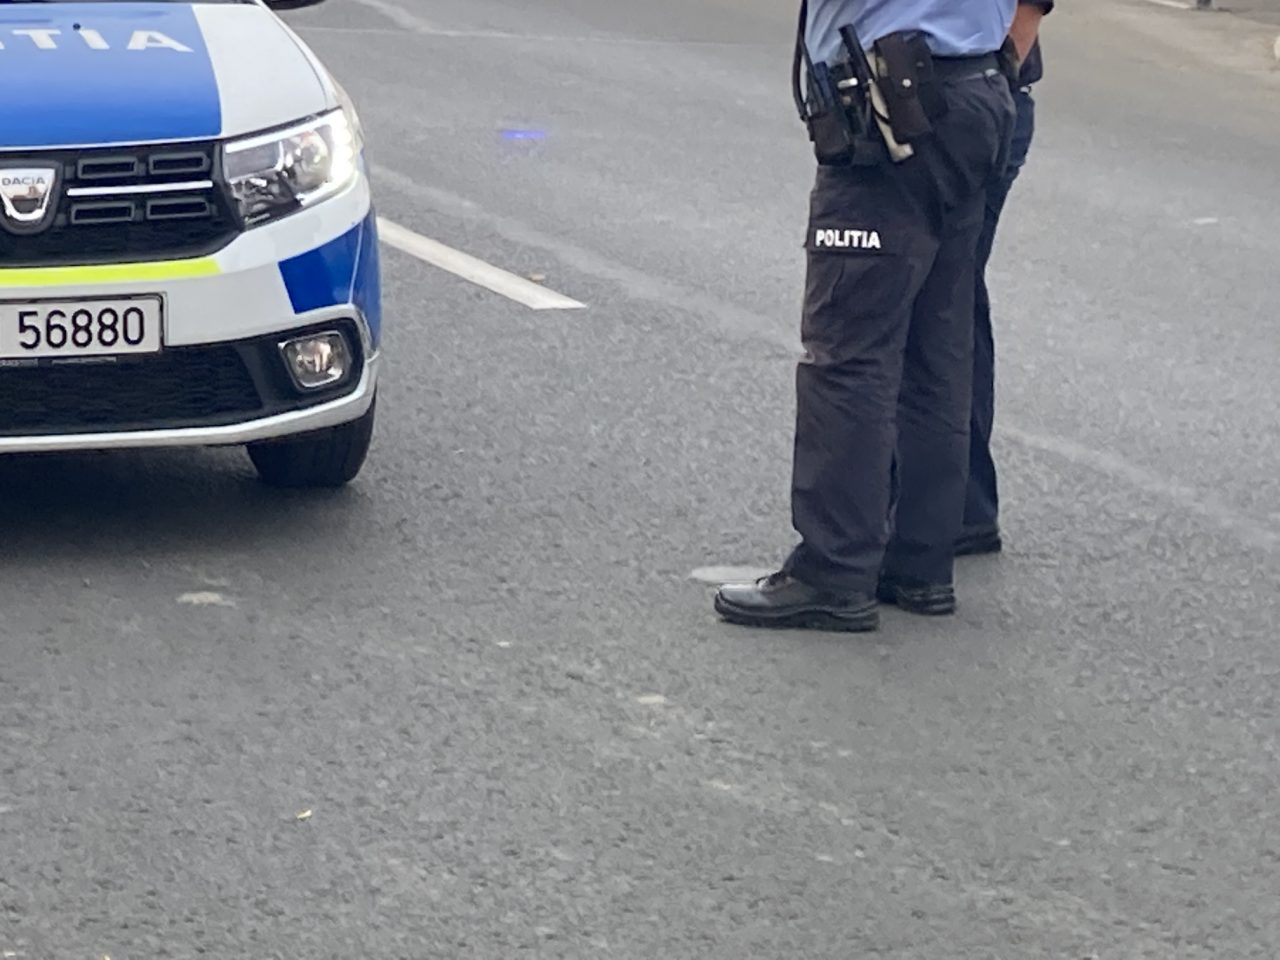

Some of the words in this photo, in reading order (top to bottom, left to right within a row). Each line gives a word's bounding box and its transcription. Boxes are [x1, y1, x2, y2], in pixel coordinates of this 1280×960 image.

[1, 176, 46, 186] DACIA
[815, 229, 881, 249] POLITIA
[18, 306, 145, 350] 56880
